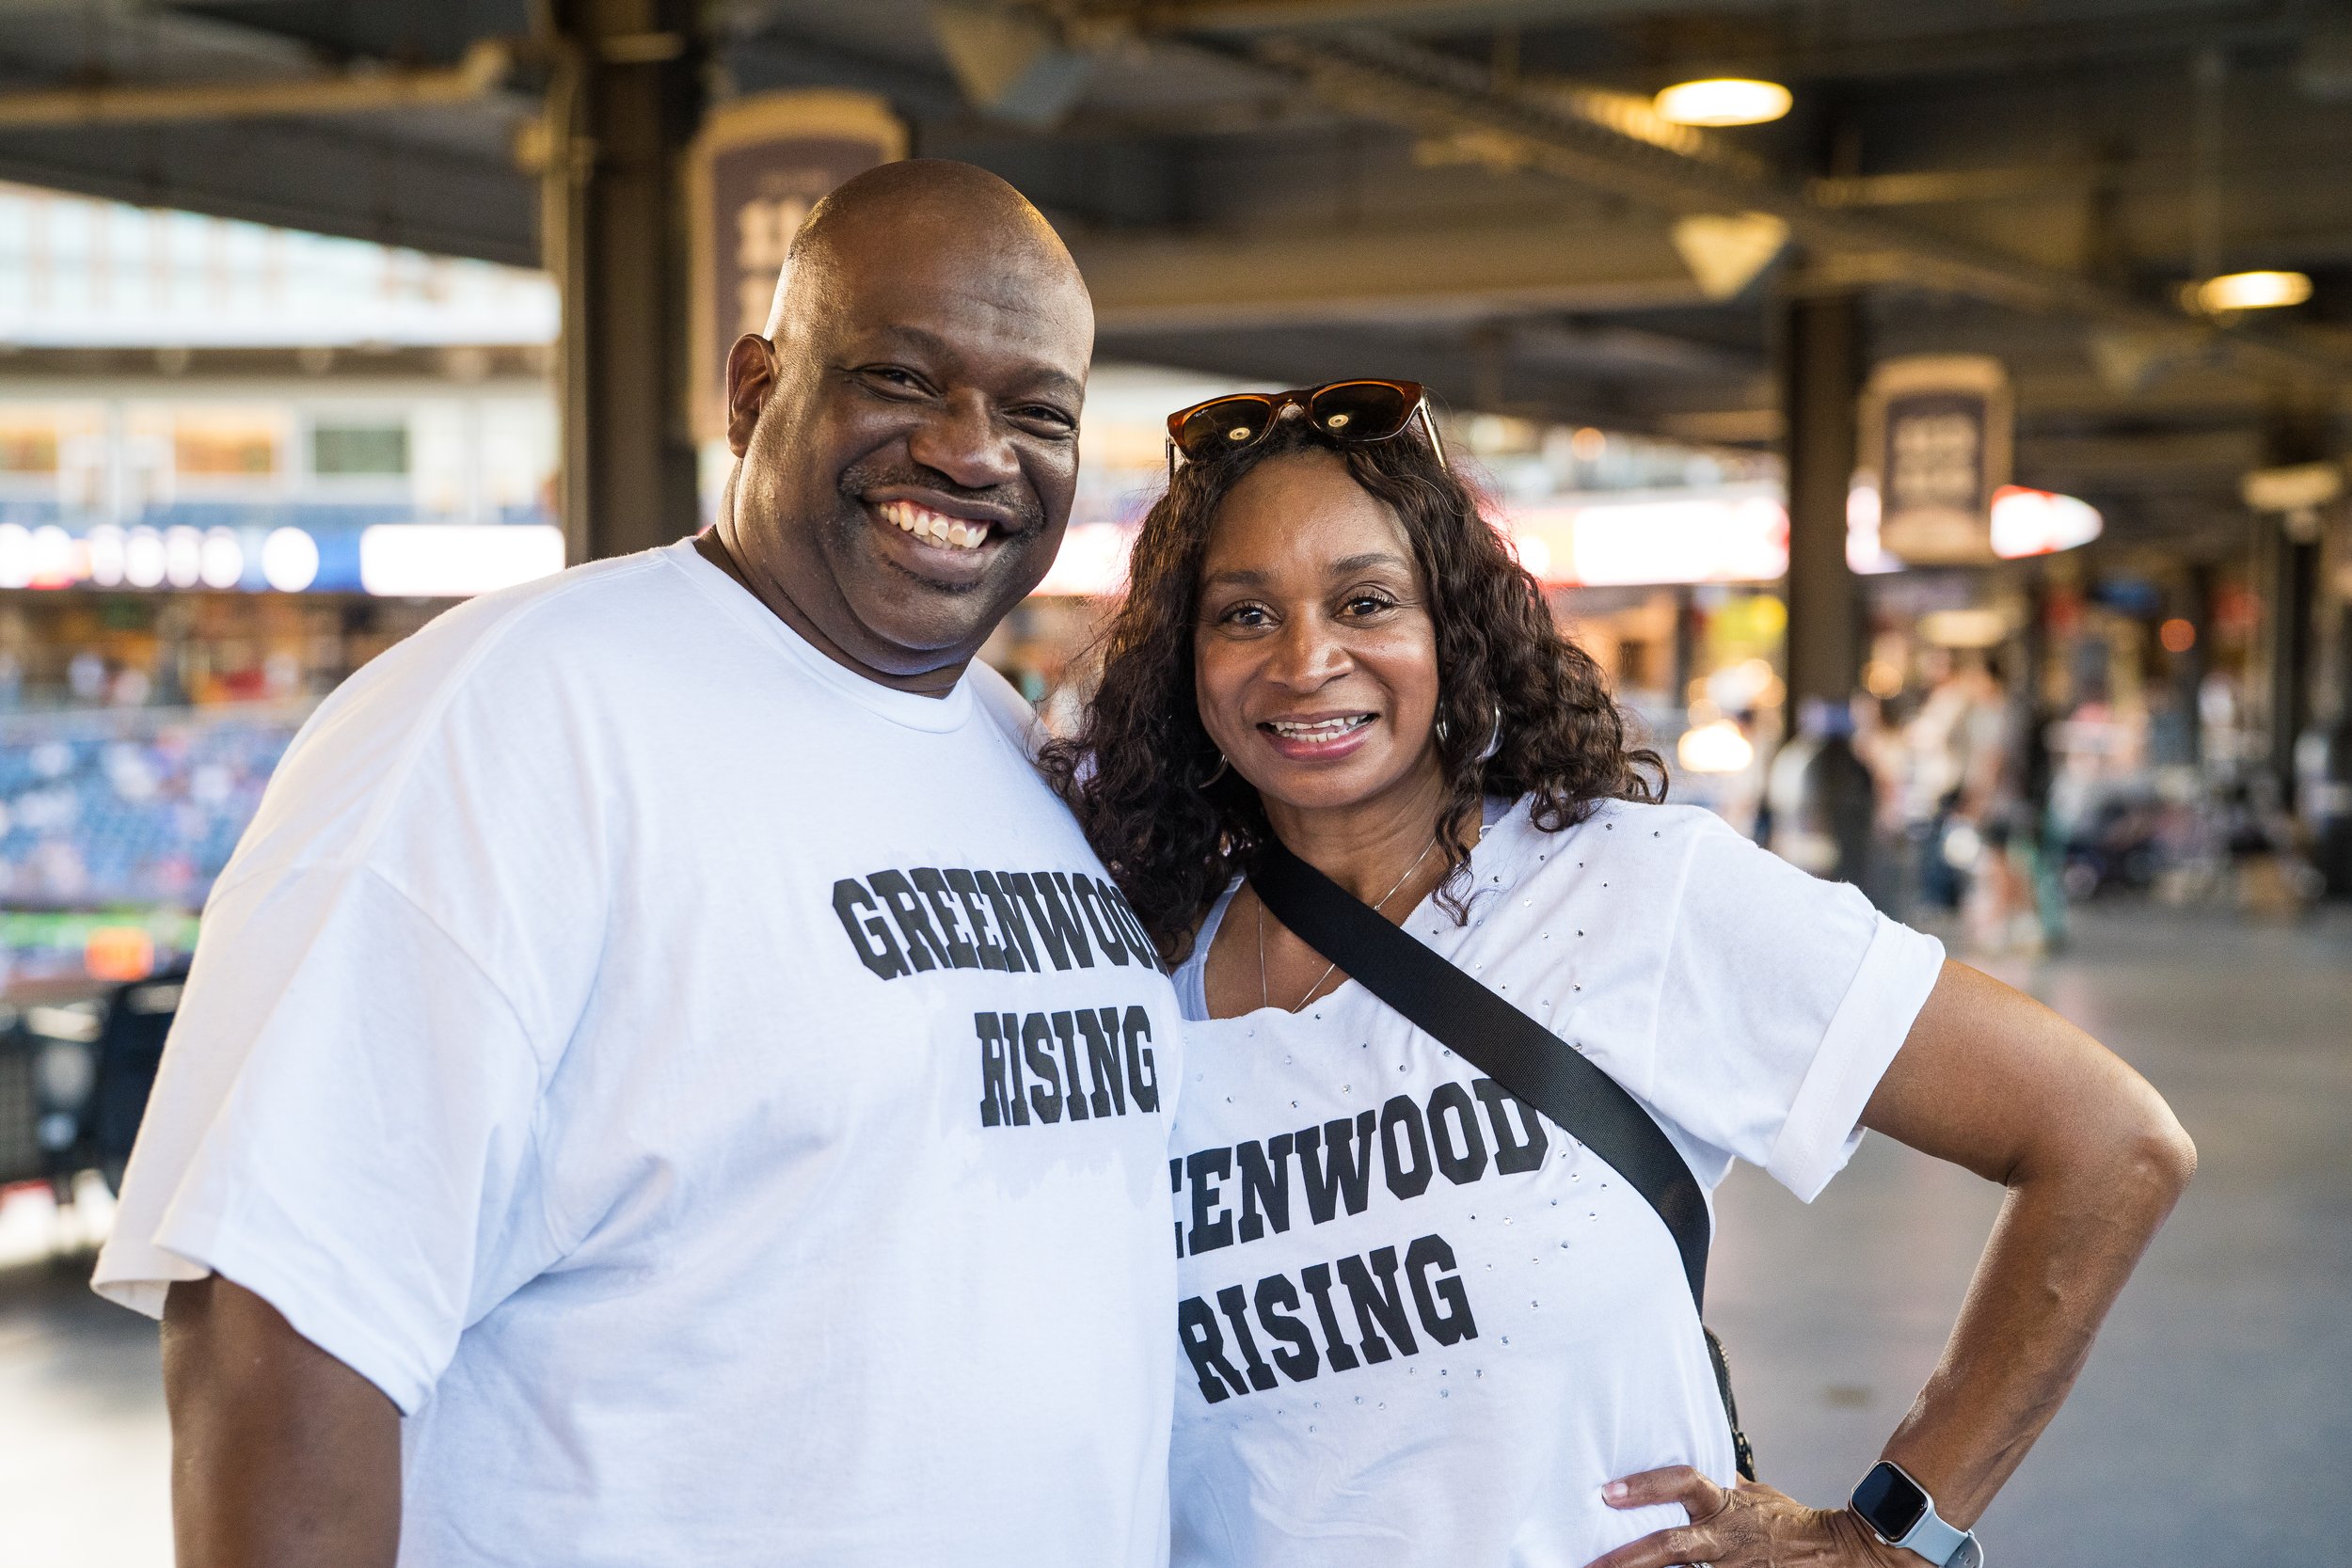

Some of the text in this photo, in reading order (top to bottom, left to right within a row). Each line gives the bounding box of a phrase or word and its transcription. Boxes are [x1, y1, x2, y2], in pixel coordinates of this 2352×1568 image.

[975, 1006, 1160, 1127] RISING
[1169, 1077, 1549, 1259] ENWOOD
[1178, 1233, 1479, 1404] RISING
